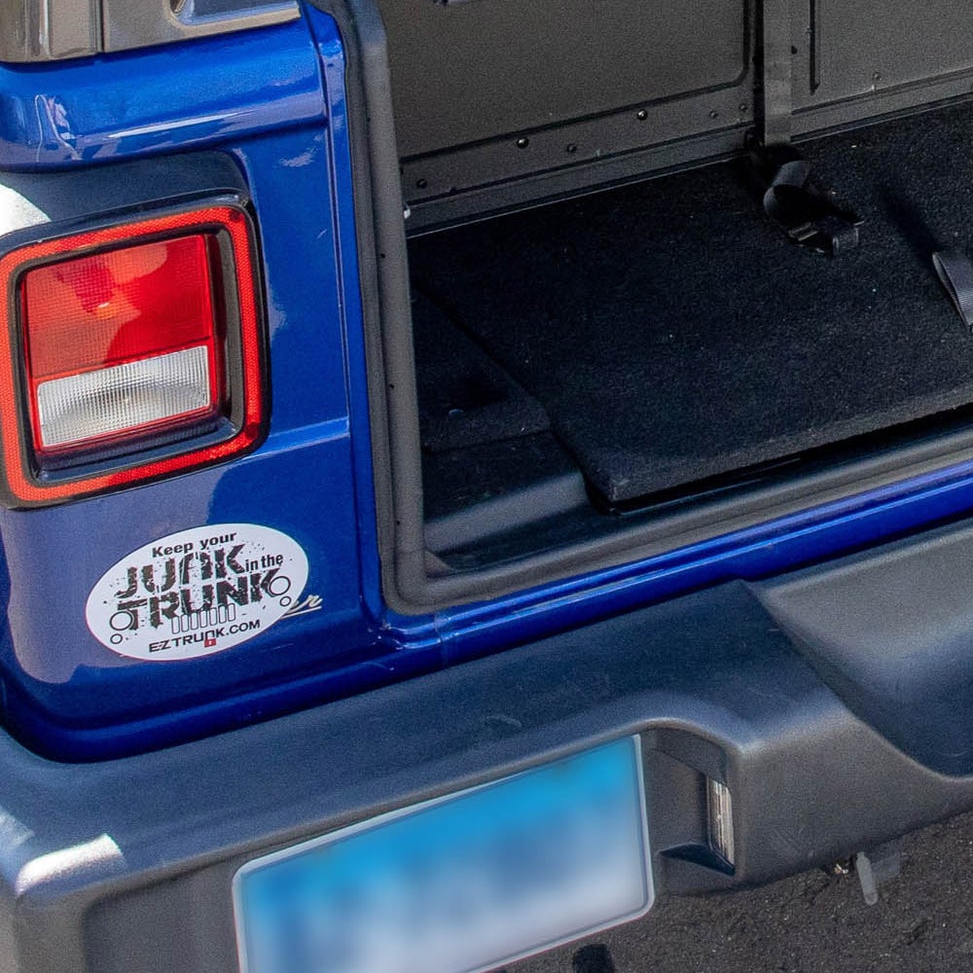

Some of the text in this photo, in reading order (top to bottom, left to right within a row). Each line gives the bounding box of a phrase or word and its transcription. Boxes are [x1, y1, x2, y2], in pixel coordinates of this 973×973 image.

[114, 544, 284, 599] JUNK in the
[152, 532, 237, 558] Keep your
[117, 567, 279, 630] TRUNK
